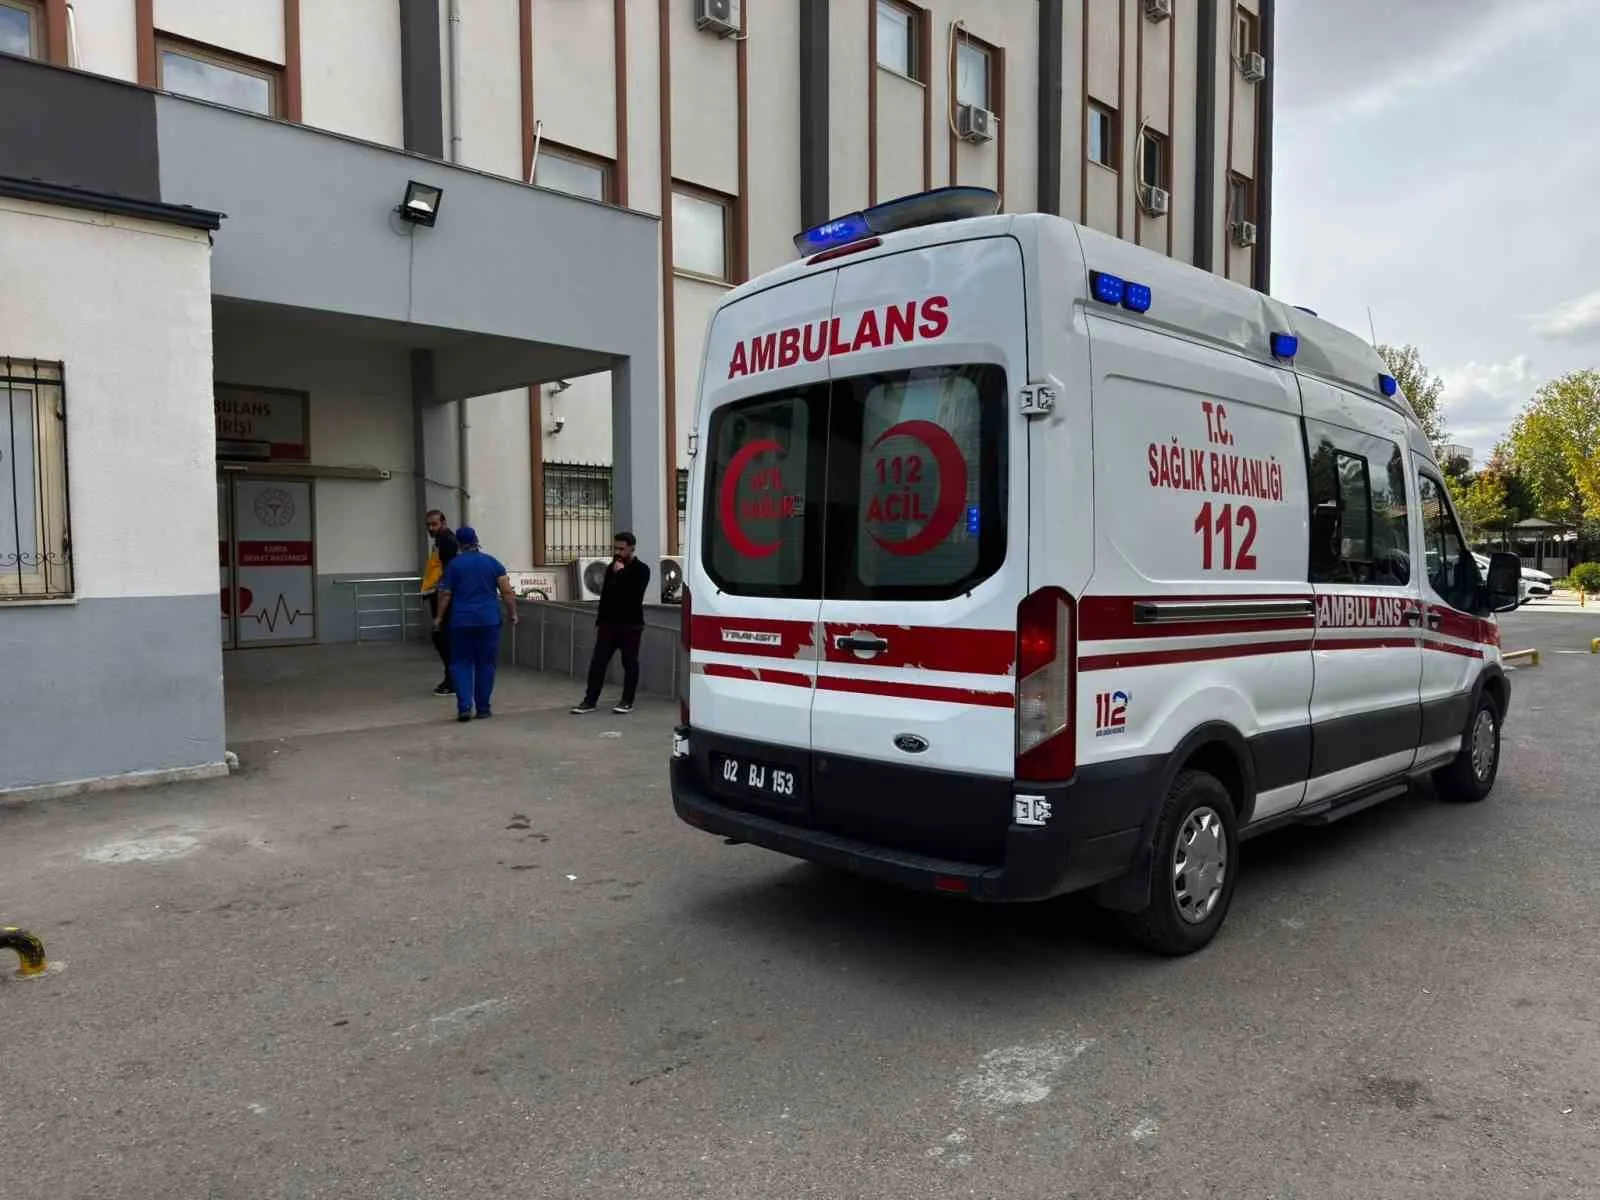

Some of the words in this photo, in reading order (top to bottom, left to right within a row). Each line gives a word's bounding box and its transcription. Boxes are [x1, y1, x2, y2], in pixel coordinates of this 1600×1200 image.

[728, 296, 949, 379] AMBULANS
[215, 398, 271, 417] BULANS
[1202, 401, 1234, 446] T.C.
[217, 416, 253, 437] İRİŞİ
[874, 455, 922, 484] 112
[1148, 435, 1206, 492] SAĞLIK
[1210, 452, 1283, 501] BAKANLIĞI
[866, 487, 928, 522] ACİL
[1194, 501, 1257, 570] 112
[1319, 596, 1402, 627] AMBULANS
[723, 631, 780, 643] TRANSIT
[1096, 690, 1128, 729] 112
[724, 760, 739, 782] 02
[749, 764, 765, 788] BJ
[772, 769, 794, 795] 153
